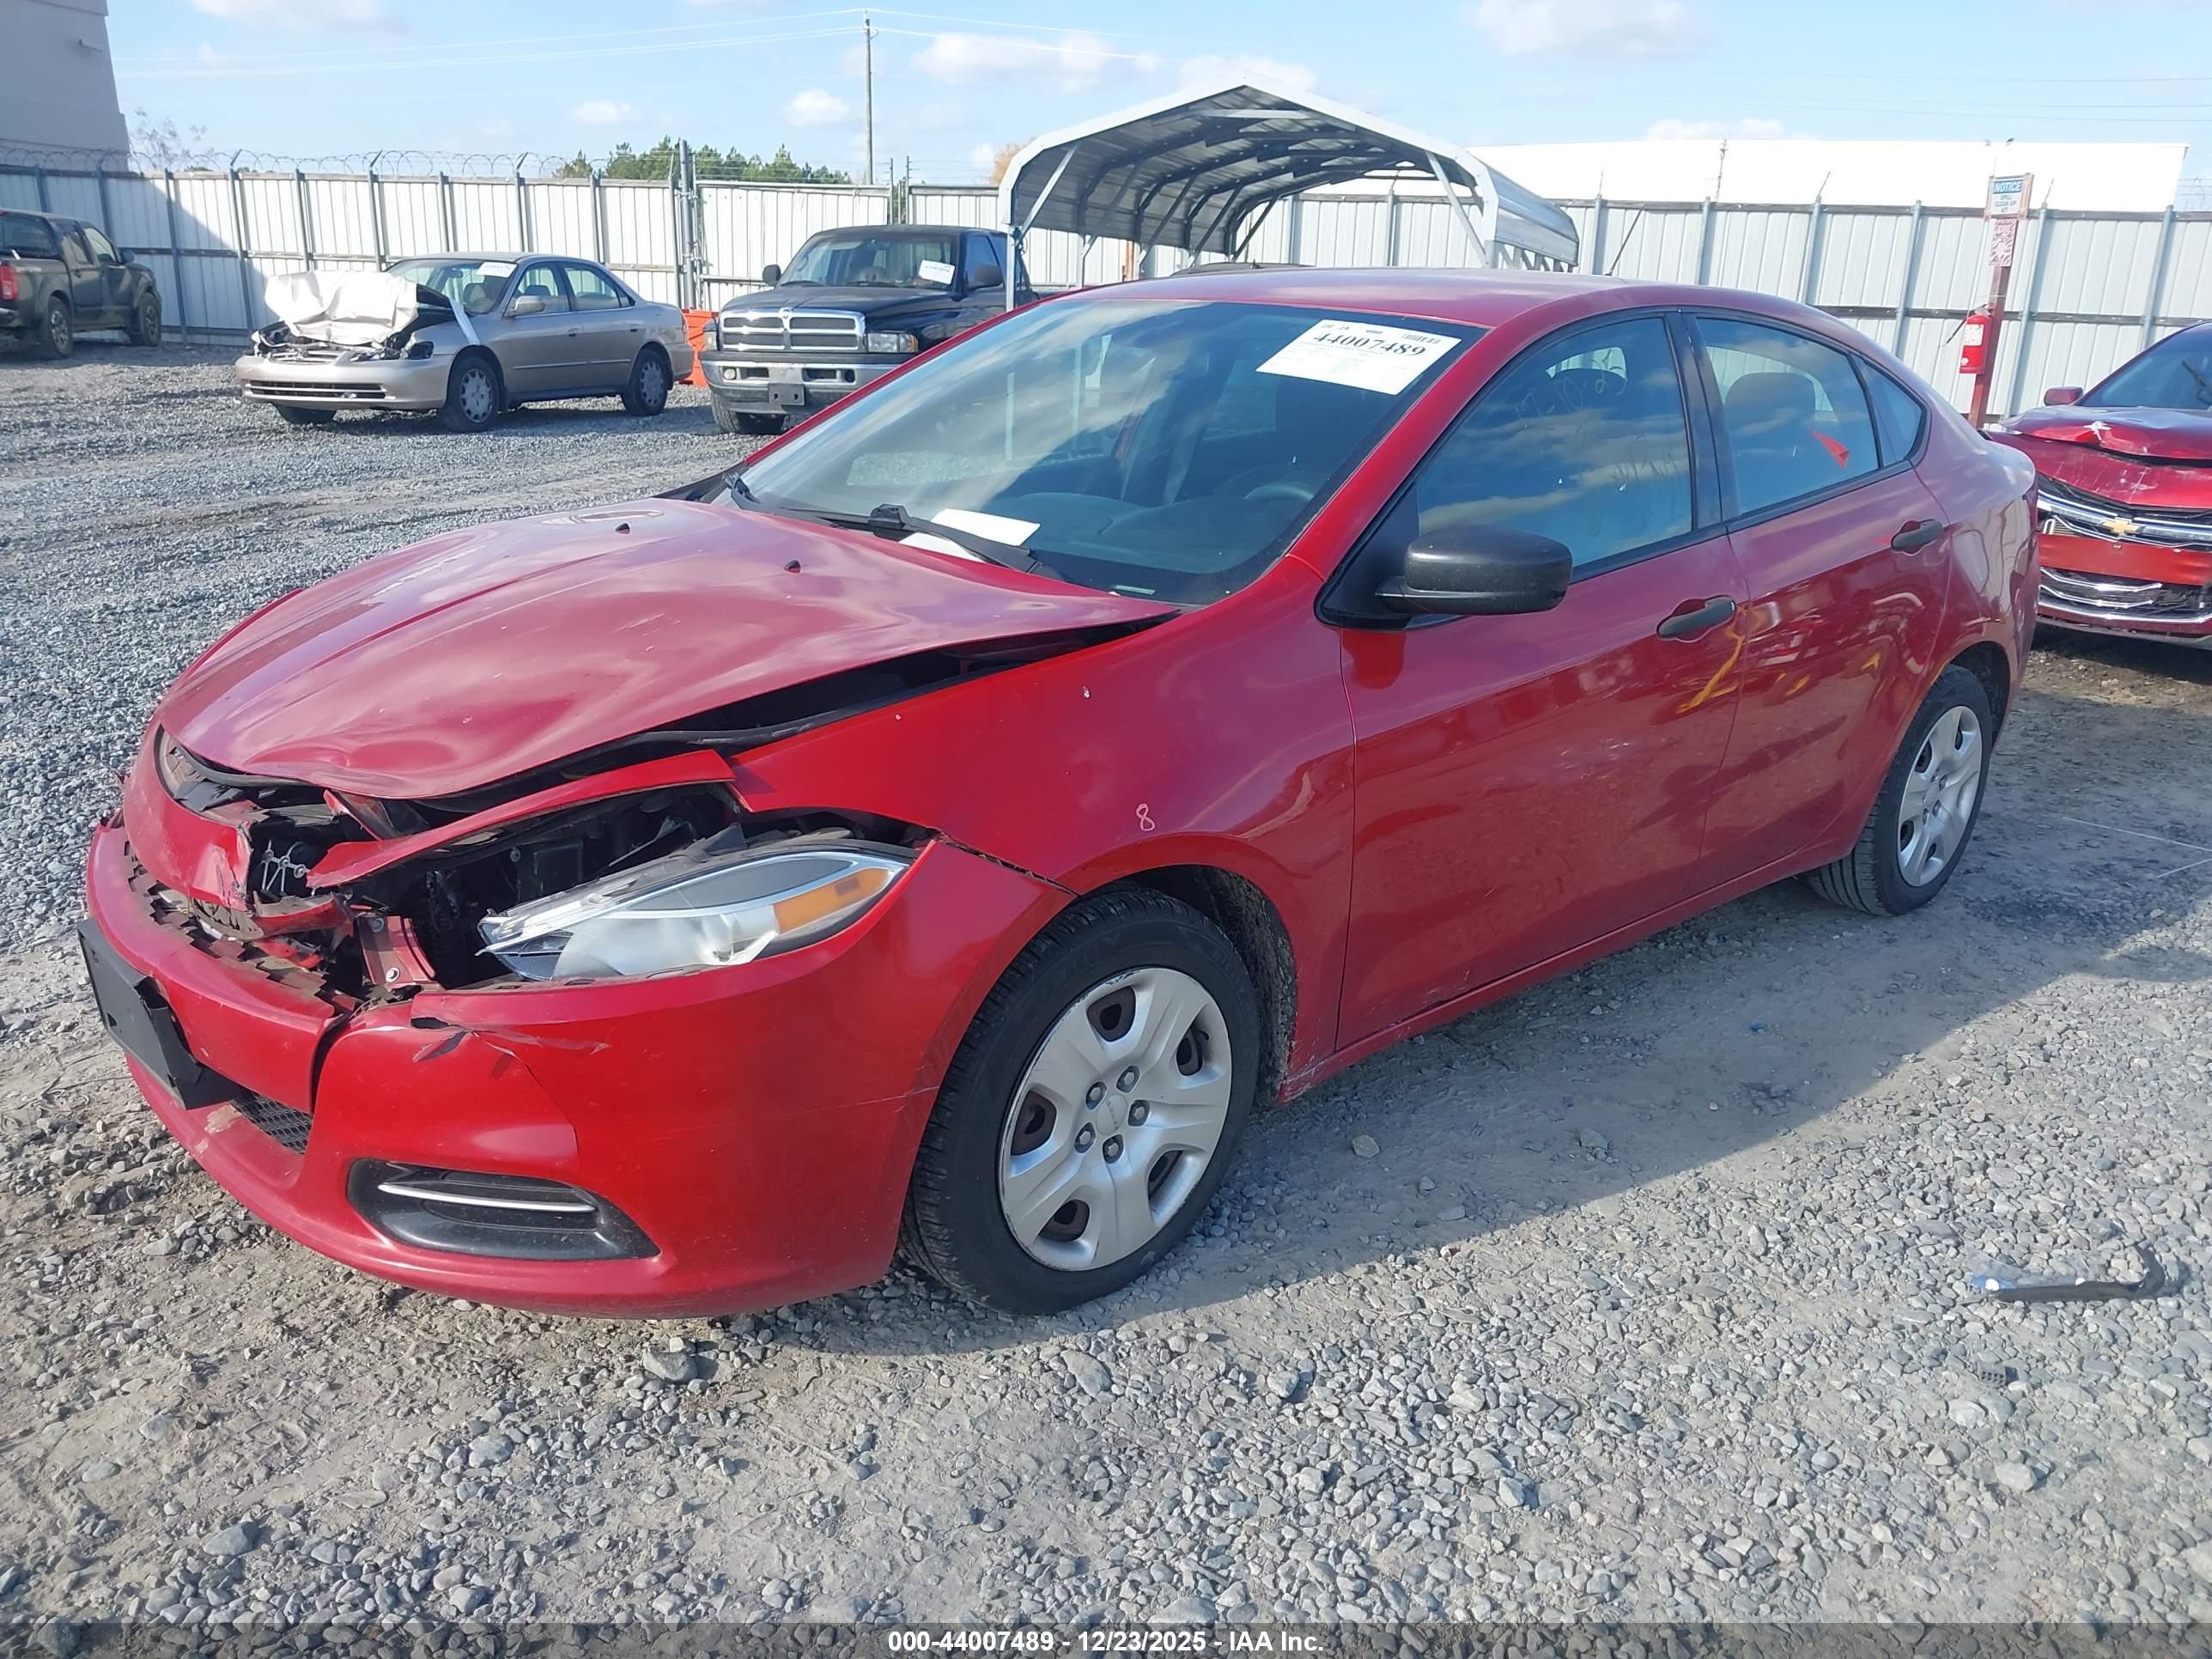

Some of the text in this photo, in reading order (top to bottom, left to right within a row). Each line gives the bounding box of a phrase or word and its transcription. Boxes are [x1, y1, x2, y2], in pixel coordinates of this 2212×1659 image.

[1994, 181, 2021, 192] NOTICE
[1313, 332, 1426, 356] 44007489
[1136, 803, 1156, 832] 8
